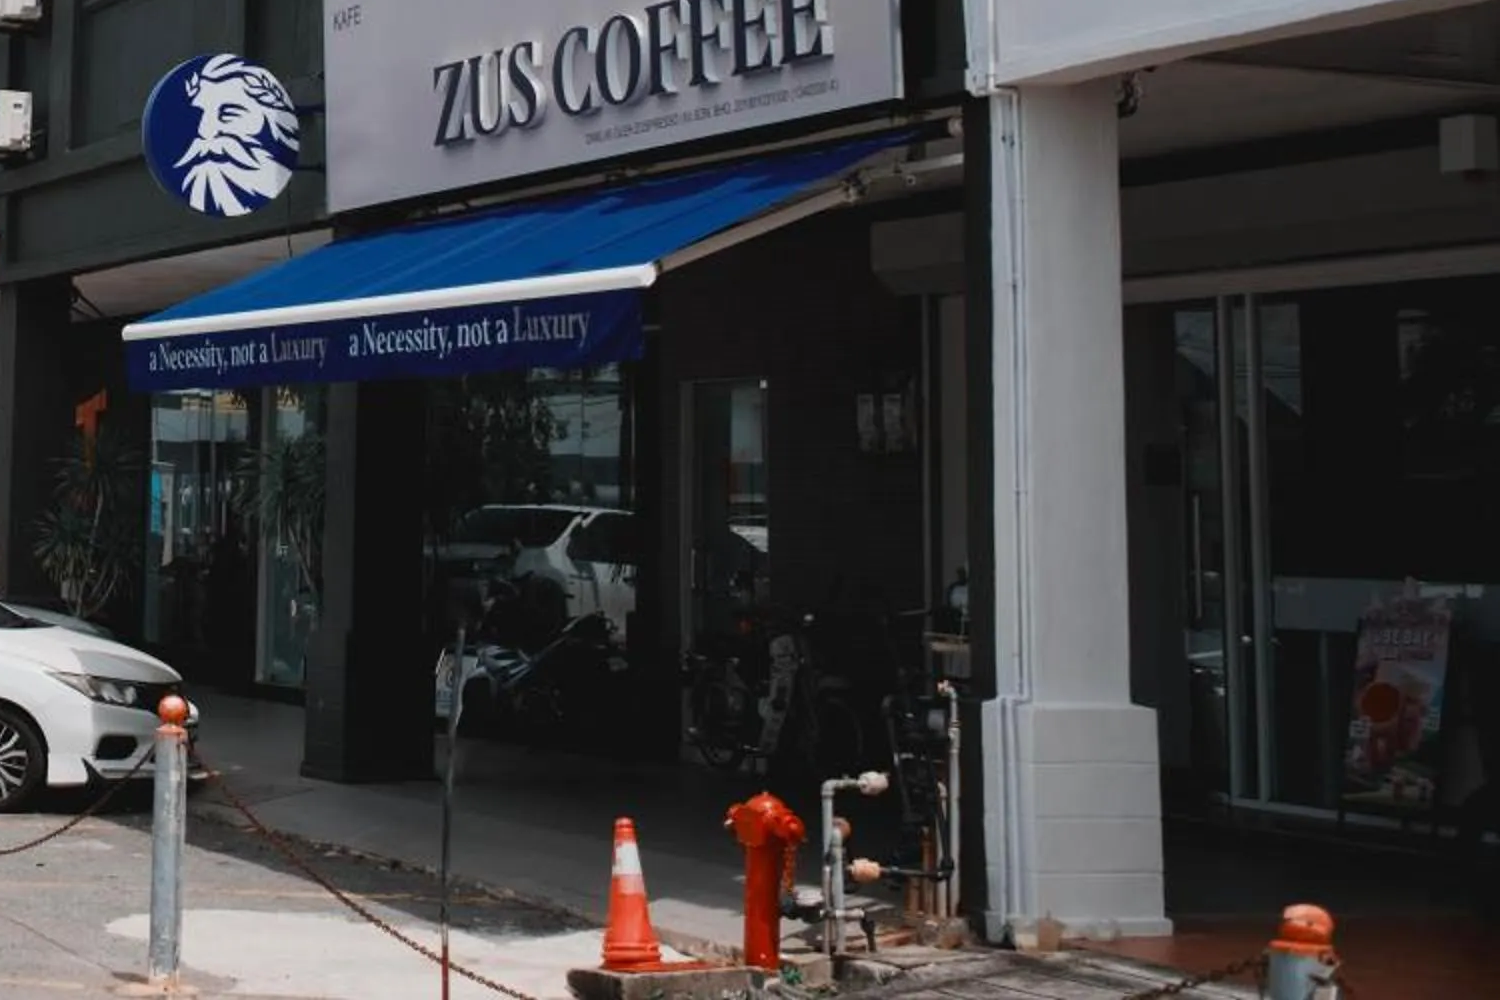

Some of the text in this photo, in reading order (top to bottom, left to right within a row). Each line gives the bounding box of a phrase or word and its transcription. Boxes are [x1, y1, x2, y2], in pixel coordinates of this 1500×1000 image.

[332, 4, 362, 32] KAFE
[433, 41, 546, 147] ZUS
[149, 331, 329, 376] a Necessity, not a Luxury
[349, 305, 591, 359] a Necessity, not a Luxury
